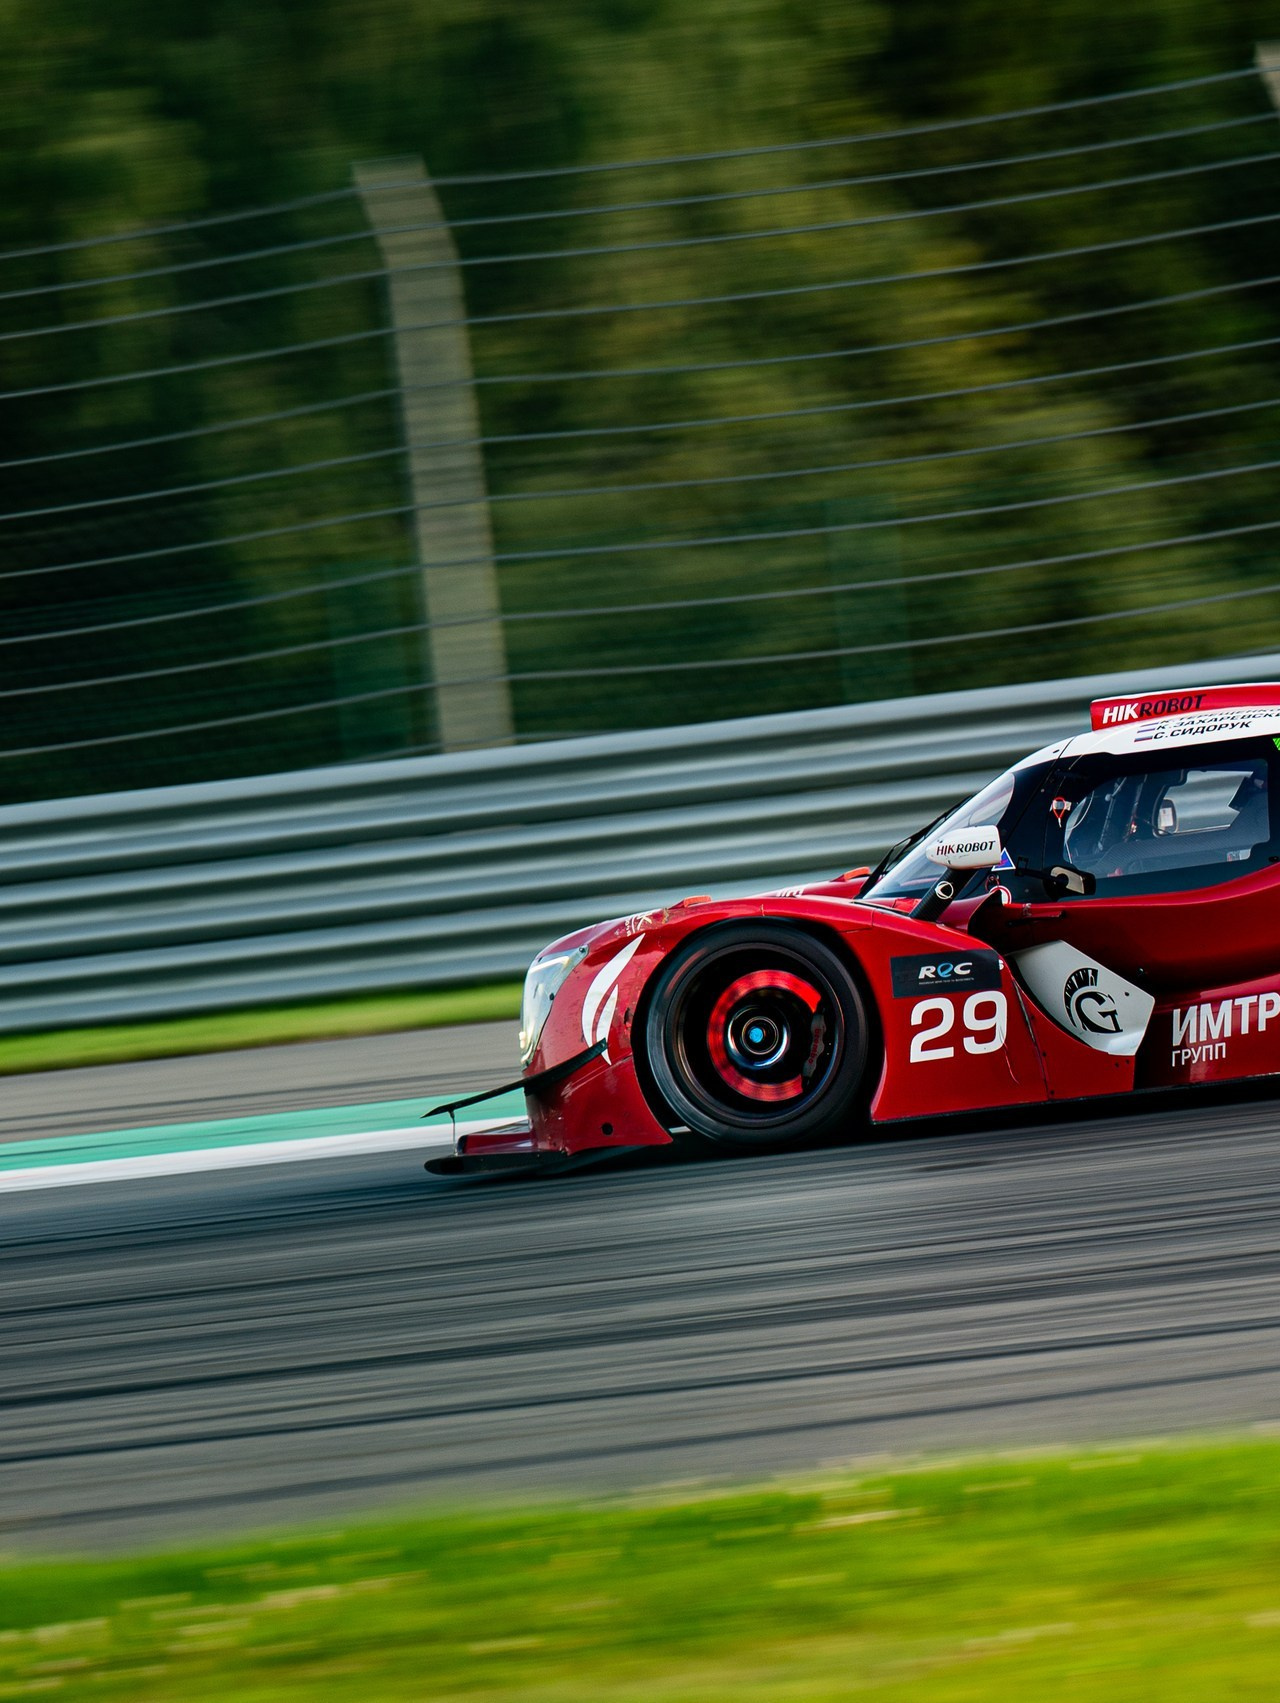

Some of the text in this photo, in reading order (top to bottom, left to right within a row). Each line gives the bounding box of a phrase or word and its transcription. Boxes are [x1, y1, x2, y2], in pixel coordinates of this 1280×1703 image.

[1102, 694, 1207, 724] HIKROBOT
[936, 840, 996, 856] HIKROBOT
[910, 990, 1007, 1064] 29
[1171, 1042, 1227, 1068] ГРУПП
